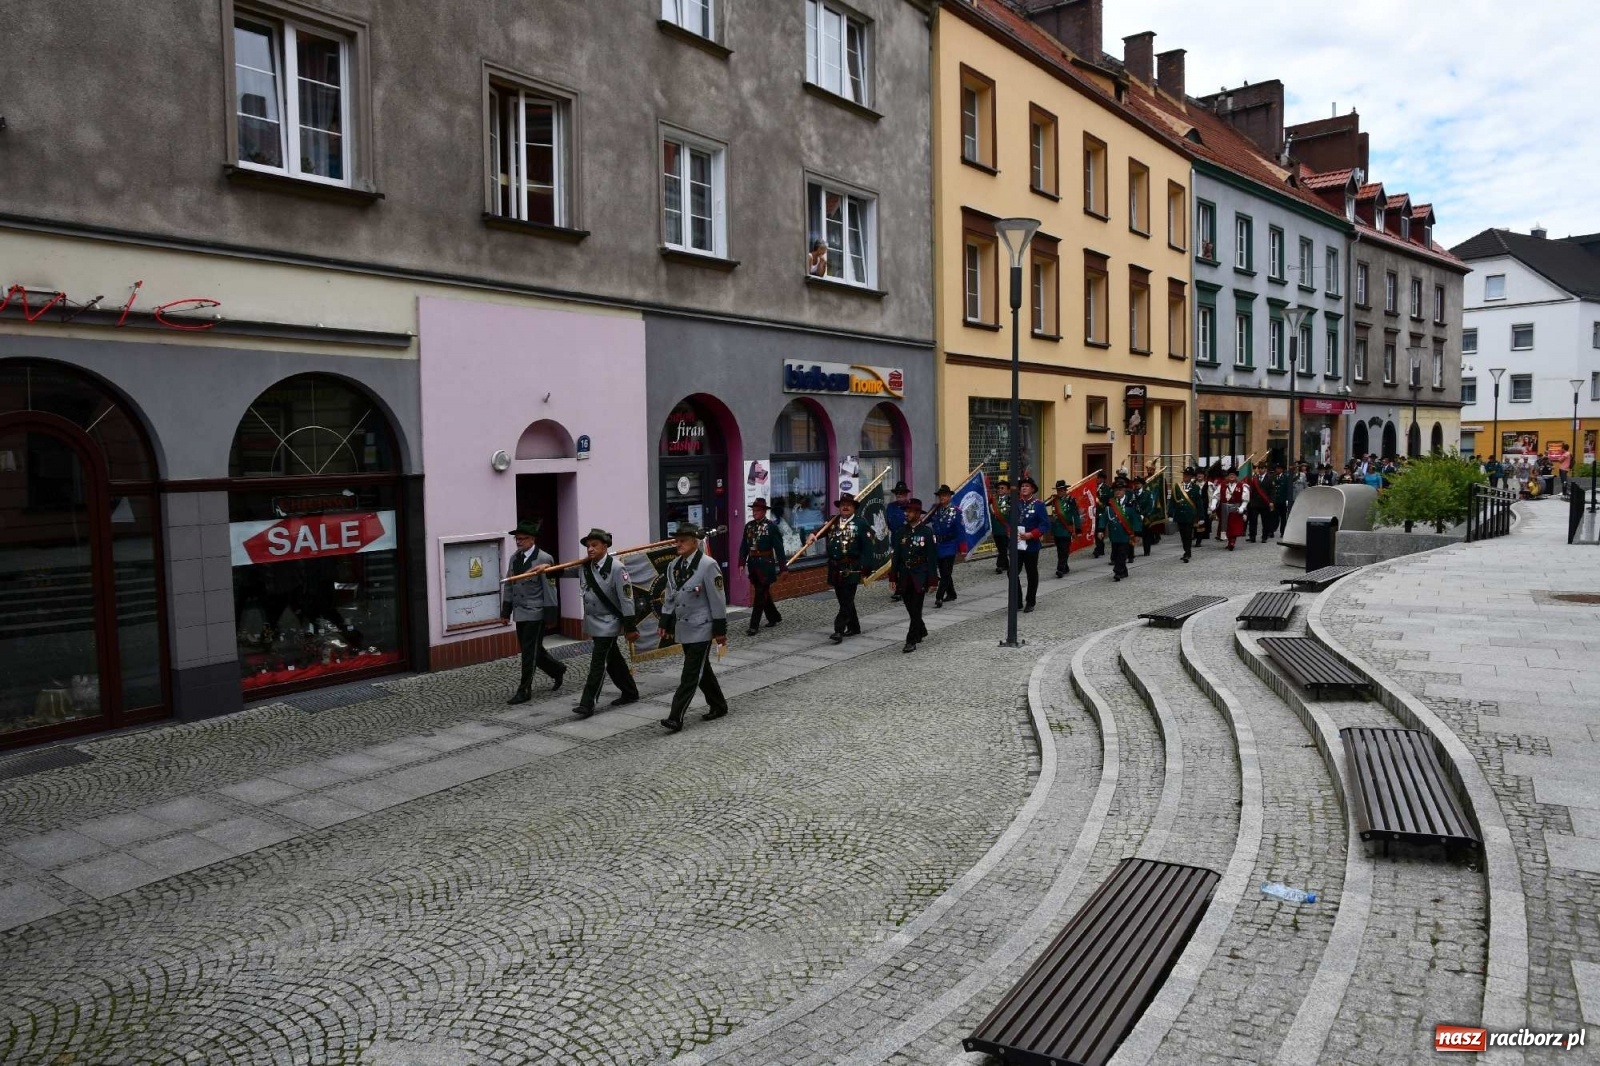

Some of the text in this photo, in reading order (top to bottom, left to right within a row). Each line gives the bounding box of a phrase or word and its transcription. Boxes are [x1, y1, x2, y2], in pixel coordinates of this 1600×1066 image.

[850, 373, 883, 394] home
[672, 419, 705, 444] firan
[580, 439, 589, 448] 16
[267, 520, 362, 556] SALE
